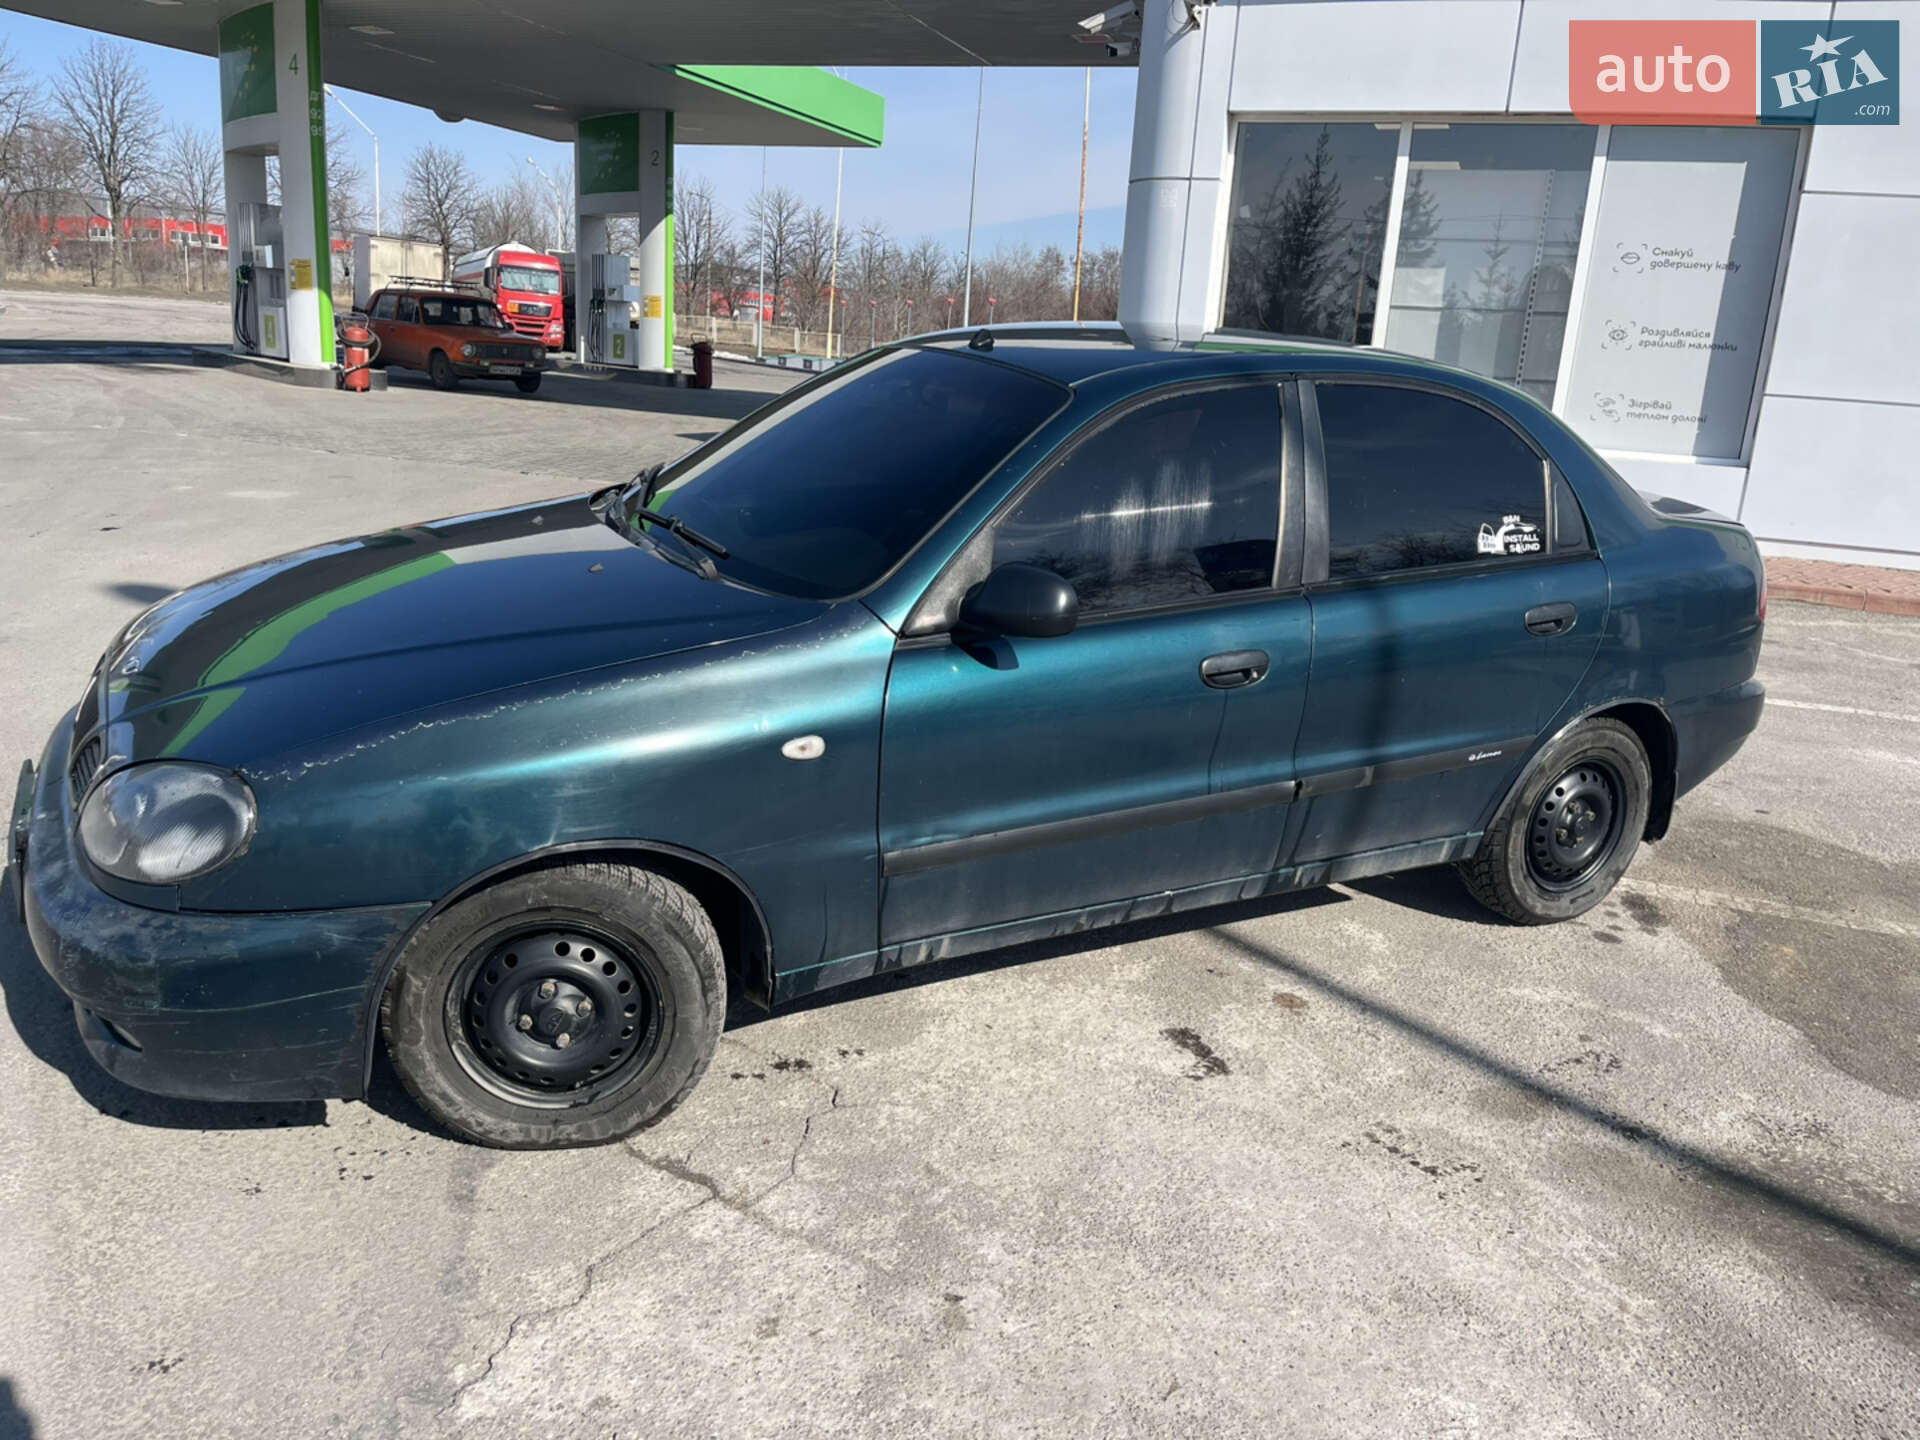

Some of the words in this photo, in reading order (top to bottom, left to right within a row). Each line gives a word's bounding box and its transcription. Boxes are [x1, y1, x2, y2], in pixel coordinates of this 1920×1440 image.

[288, 53, 299, 76] 4
[651, 149, 660, 167] 2
[1652, 247, 1694, 259] Снакуй
[1650, 259, 1712, 272] довершену
[1640, 326, 1711, 340] Роздивляйся
[1638, 339, 1686, 349] грайливі
[1688, 341, 1738, 352] малюнки
[1627, 397, 1672, 410] Зігрівай
[1504, 534, 1539, 543] INSTALL
